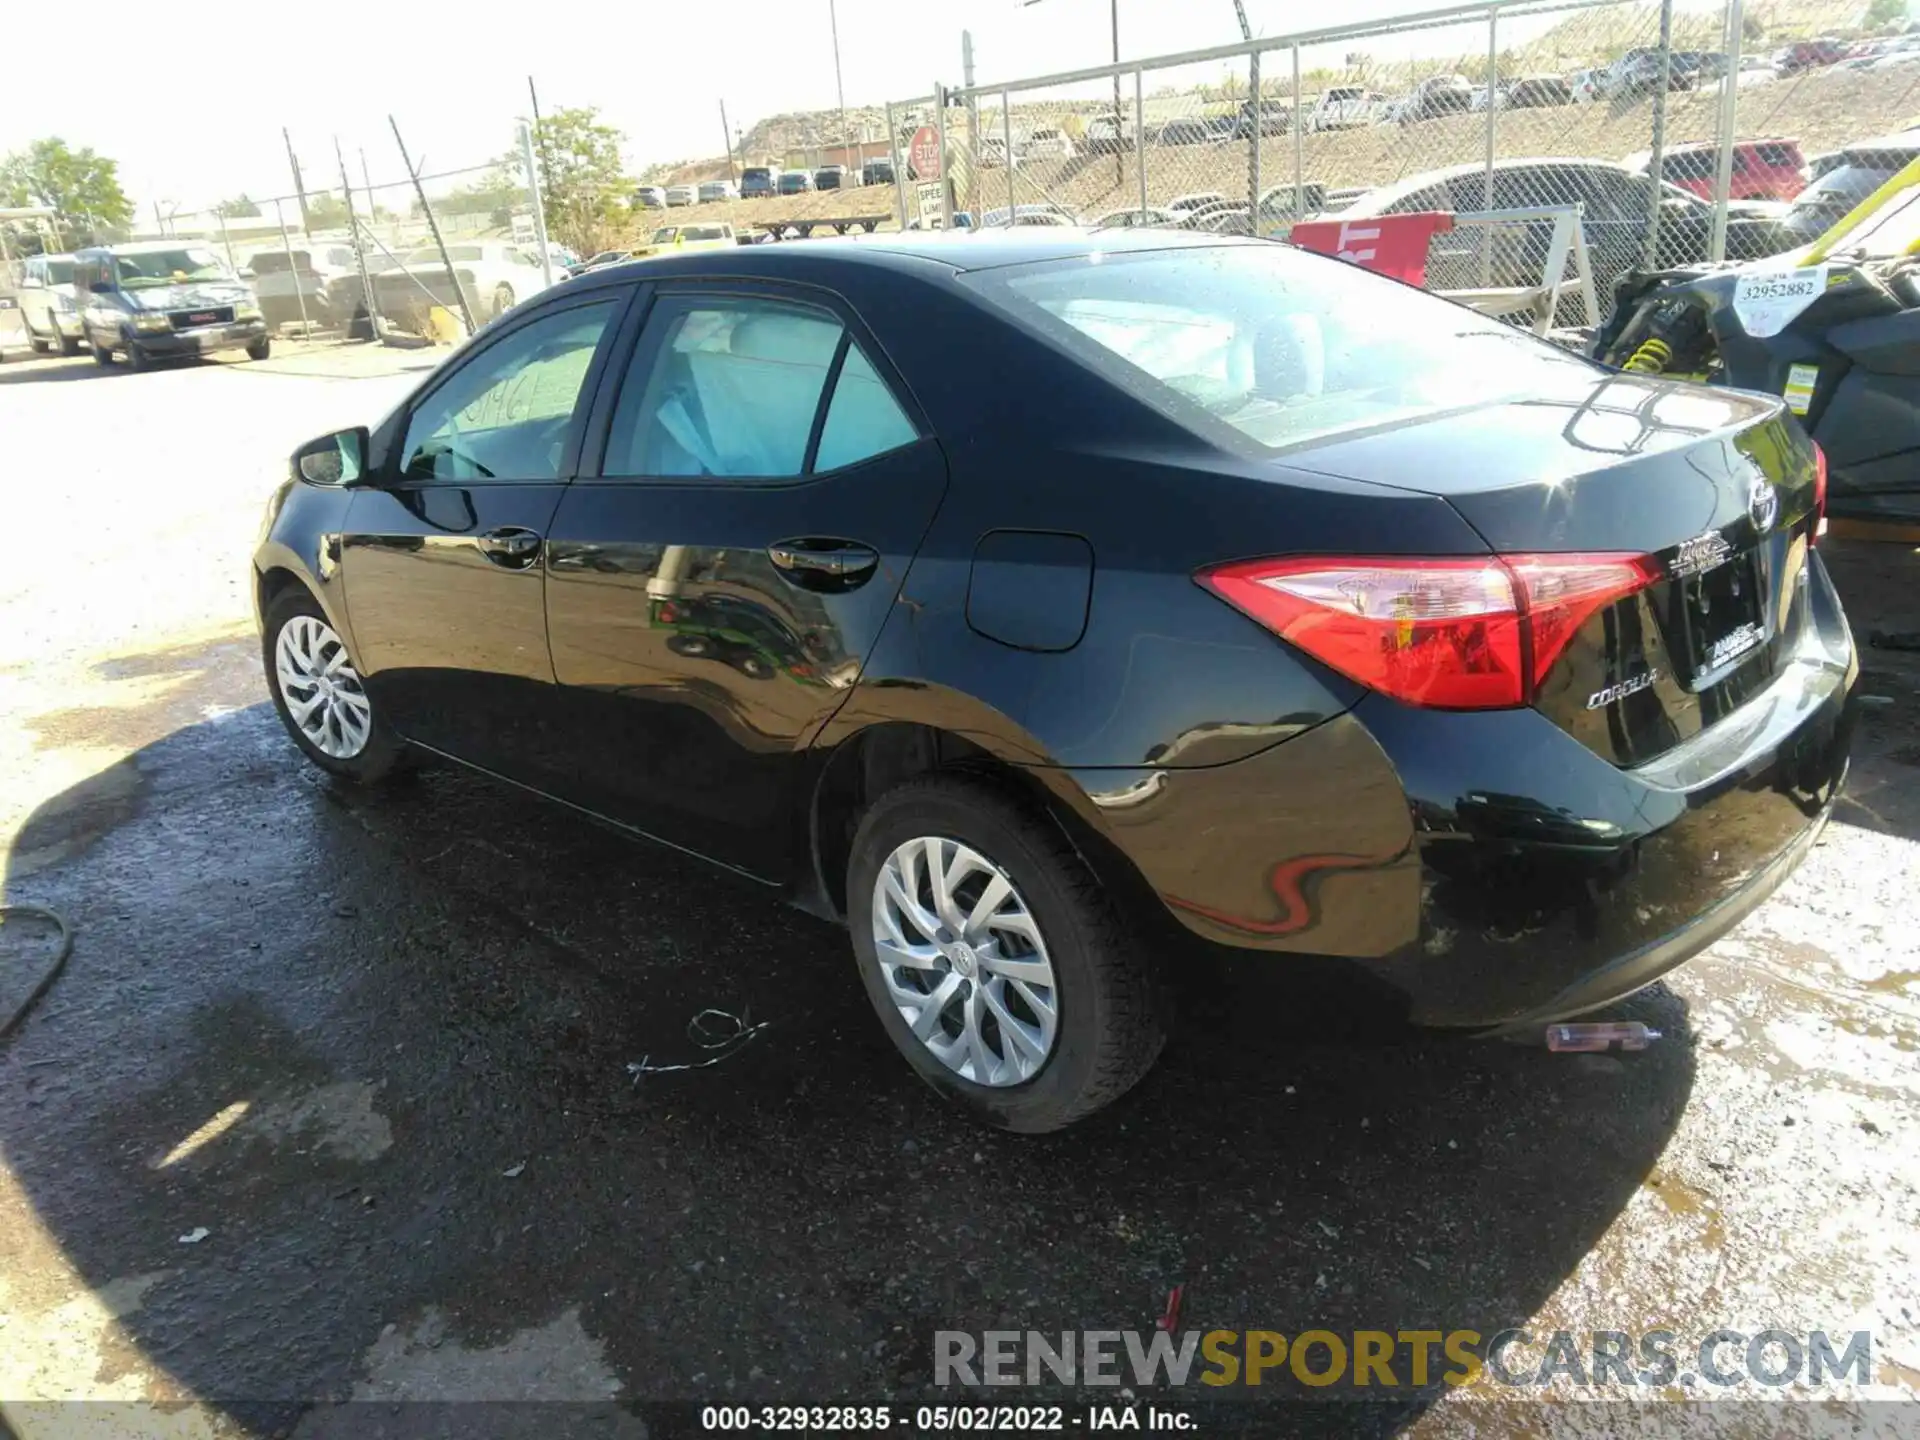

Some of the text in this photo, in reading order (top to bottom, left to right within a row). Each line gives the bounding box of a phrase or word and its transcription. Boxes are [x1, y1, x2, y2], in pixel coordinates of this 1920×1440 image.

[919, 187, 943, 201] SPEE
[923, 202, 942, 216] LIMI
[1743, 281, 1815, 300] 32952882
[1586, 668, 1658, 710] COROLLA
